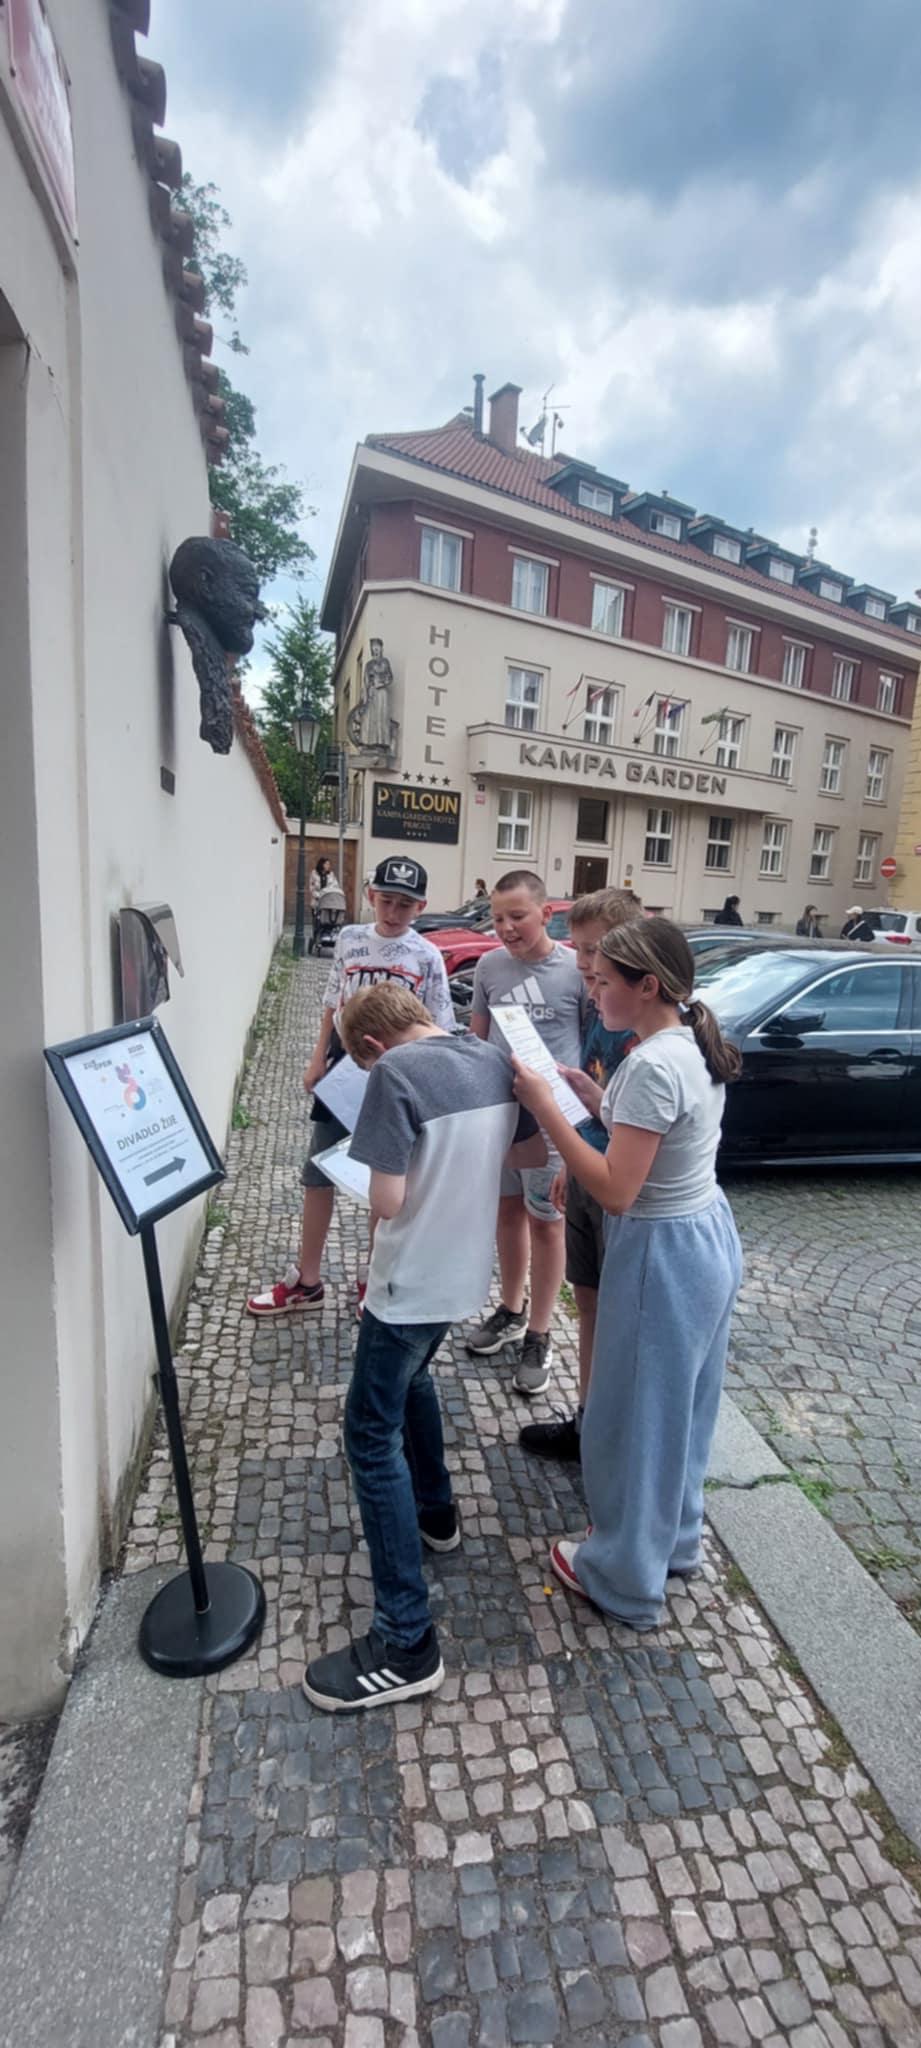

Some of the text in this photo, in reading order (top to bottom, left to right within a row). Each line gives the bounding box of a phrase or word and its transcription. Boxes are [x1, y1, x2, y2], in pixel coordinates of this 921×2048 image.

[424, 625, 451, 766] HOTEL
[519, 743, 728, 796] KAMPA GARDEN
[377, 787, 458, 814] PYTLOUN
[117, 1122, 161, 1151] DIVADLO
